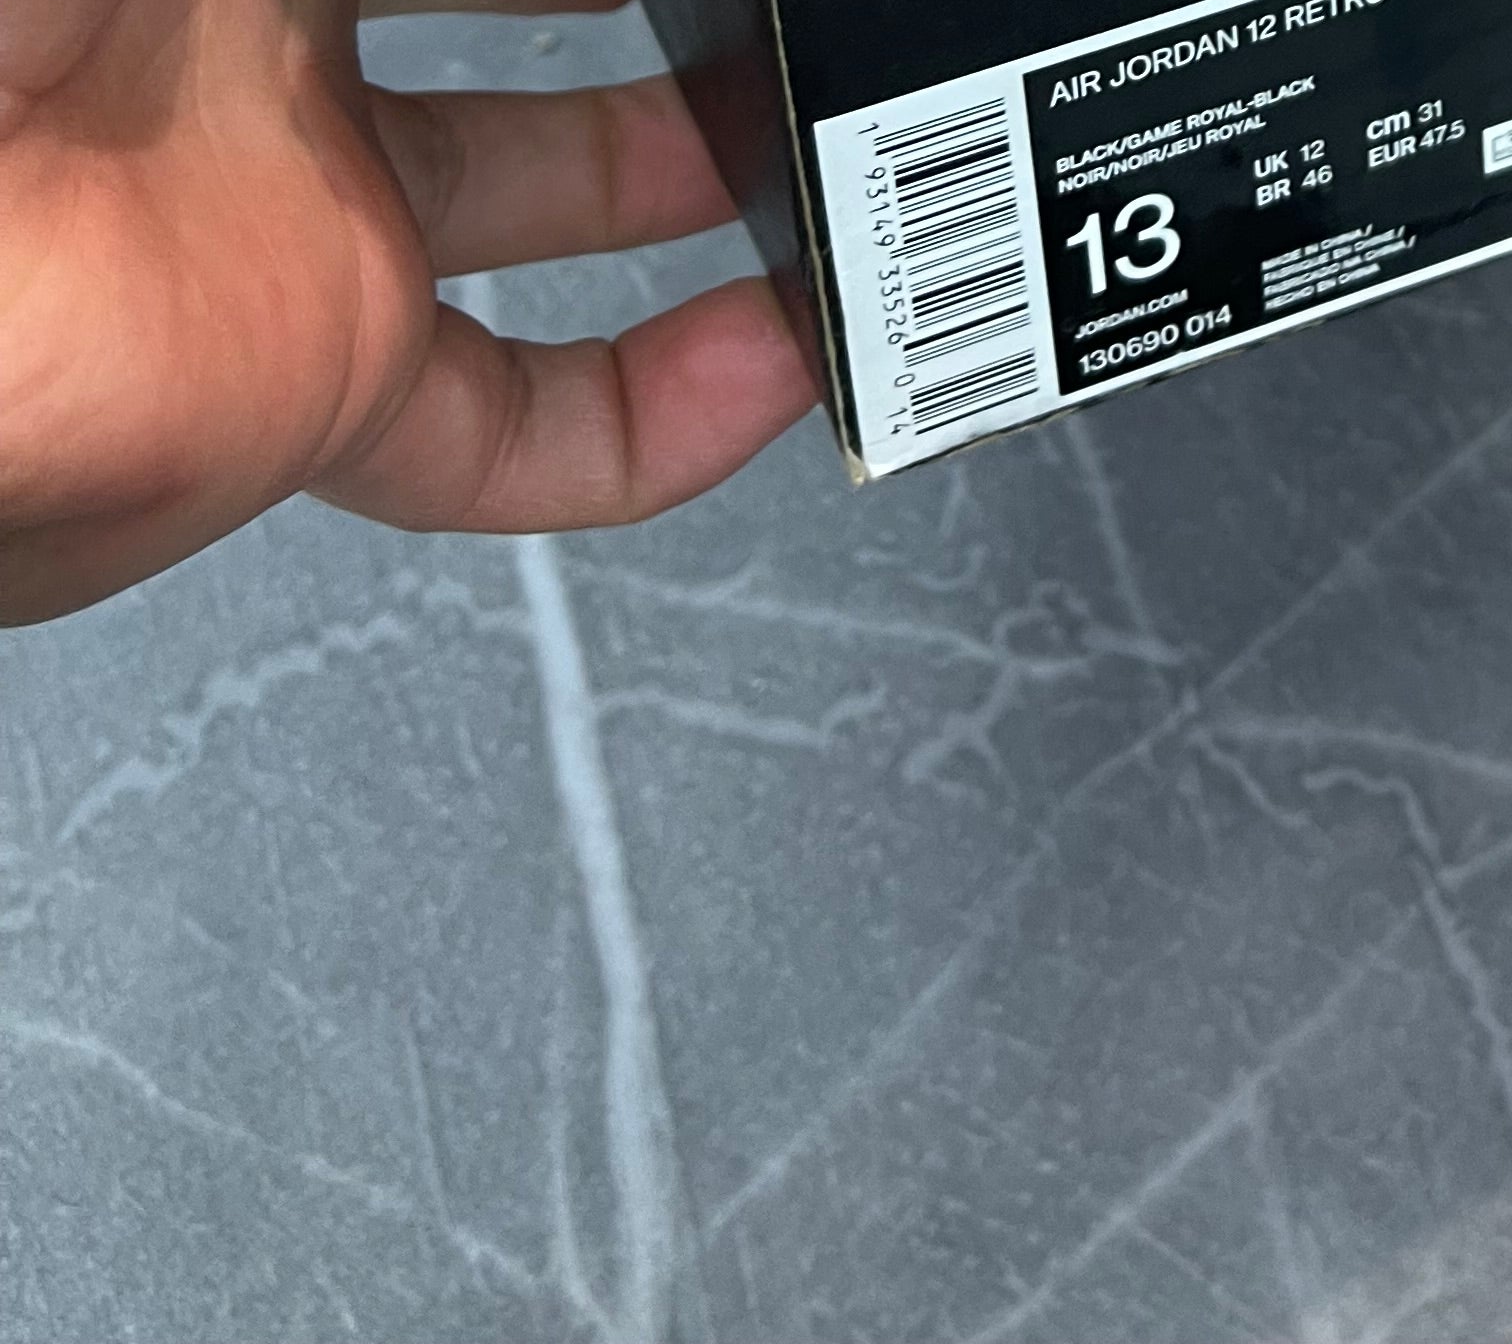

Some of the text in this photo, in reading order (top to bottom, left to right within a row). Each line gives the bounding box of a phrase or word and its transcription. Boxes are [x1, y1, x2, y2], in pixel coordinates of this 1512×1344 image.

[1049, 69, 1102, 108] AIR
[1109, 25, 1240, 89] JORDAN
[1246, 14, 1277, 43] 12
[1055, 74, 1317, 174] BLACK/GAME ROYAL-BLACK
[1366, 99, 1444, 140] cm 31
[1057, 113, 1268, 194] NOIR/NOIR/JEU ROYAL
[1254, 139, 1326, 179] UK 12
[1368, 135, 1417, 168] EUR
[1256, 165, 1334, 208] BR 46
[1066, 193, 1182, 295] 13
[1075, 288, 1189, 339] JORDAN.COM
[1078, 304, 1233, 374] 130690 014
